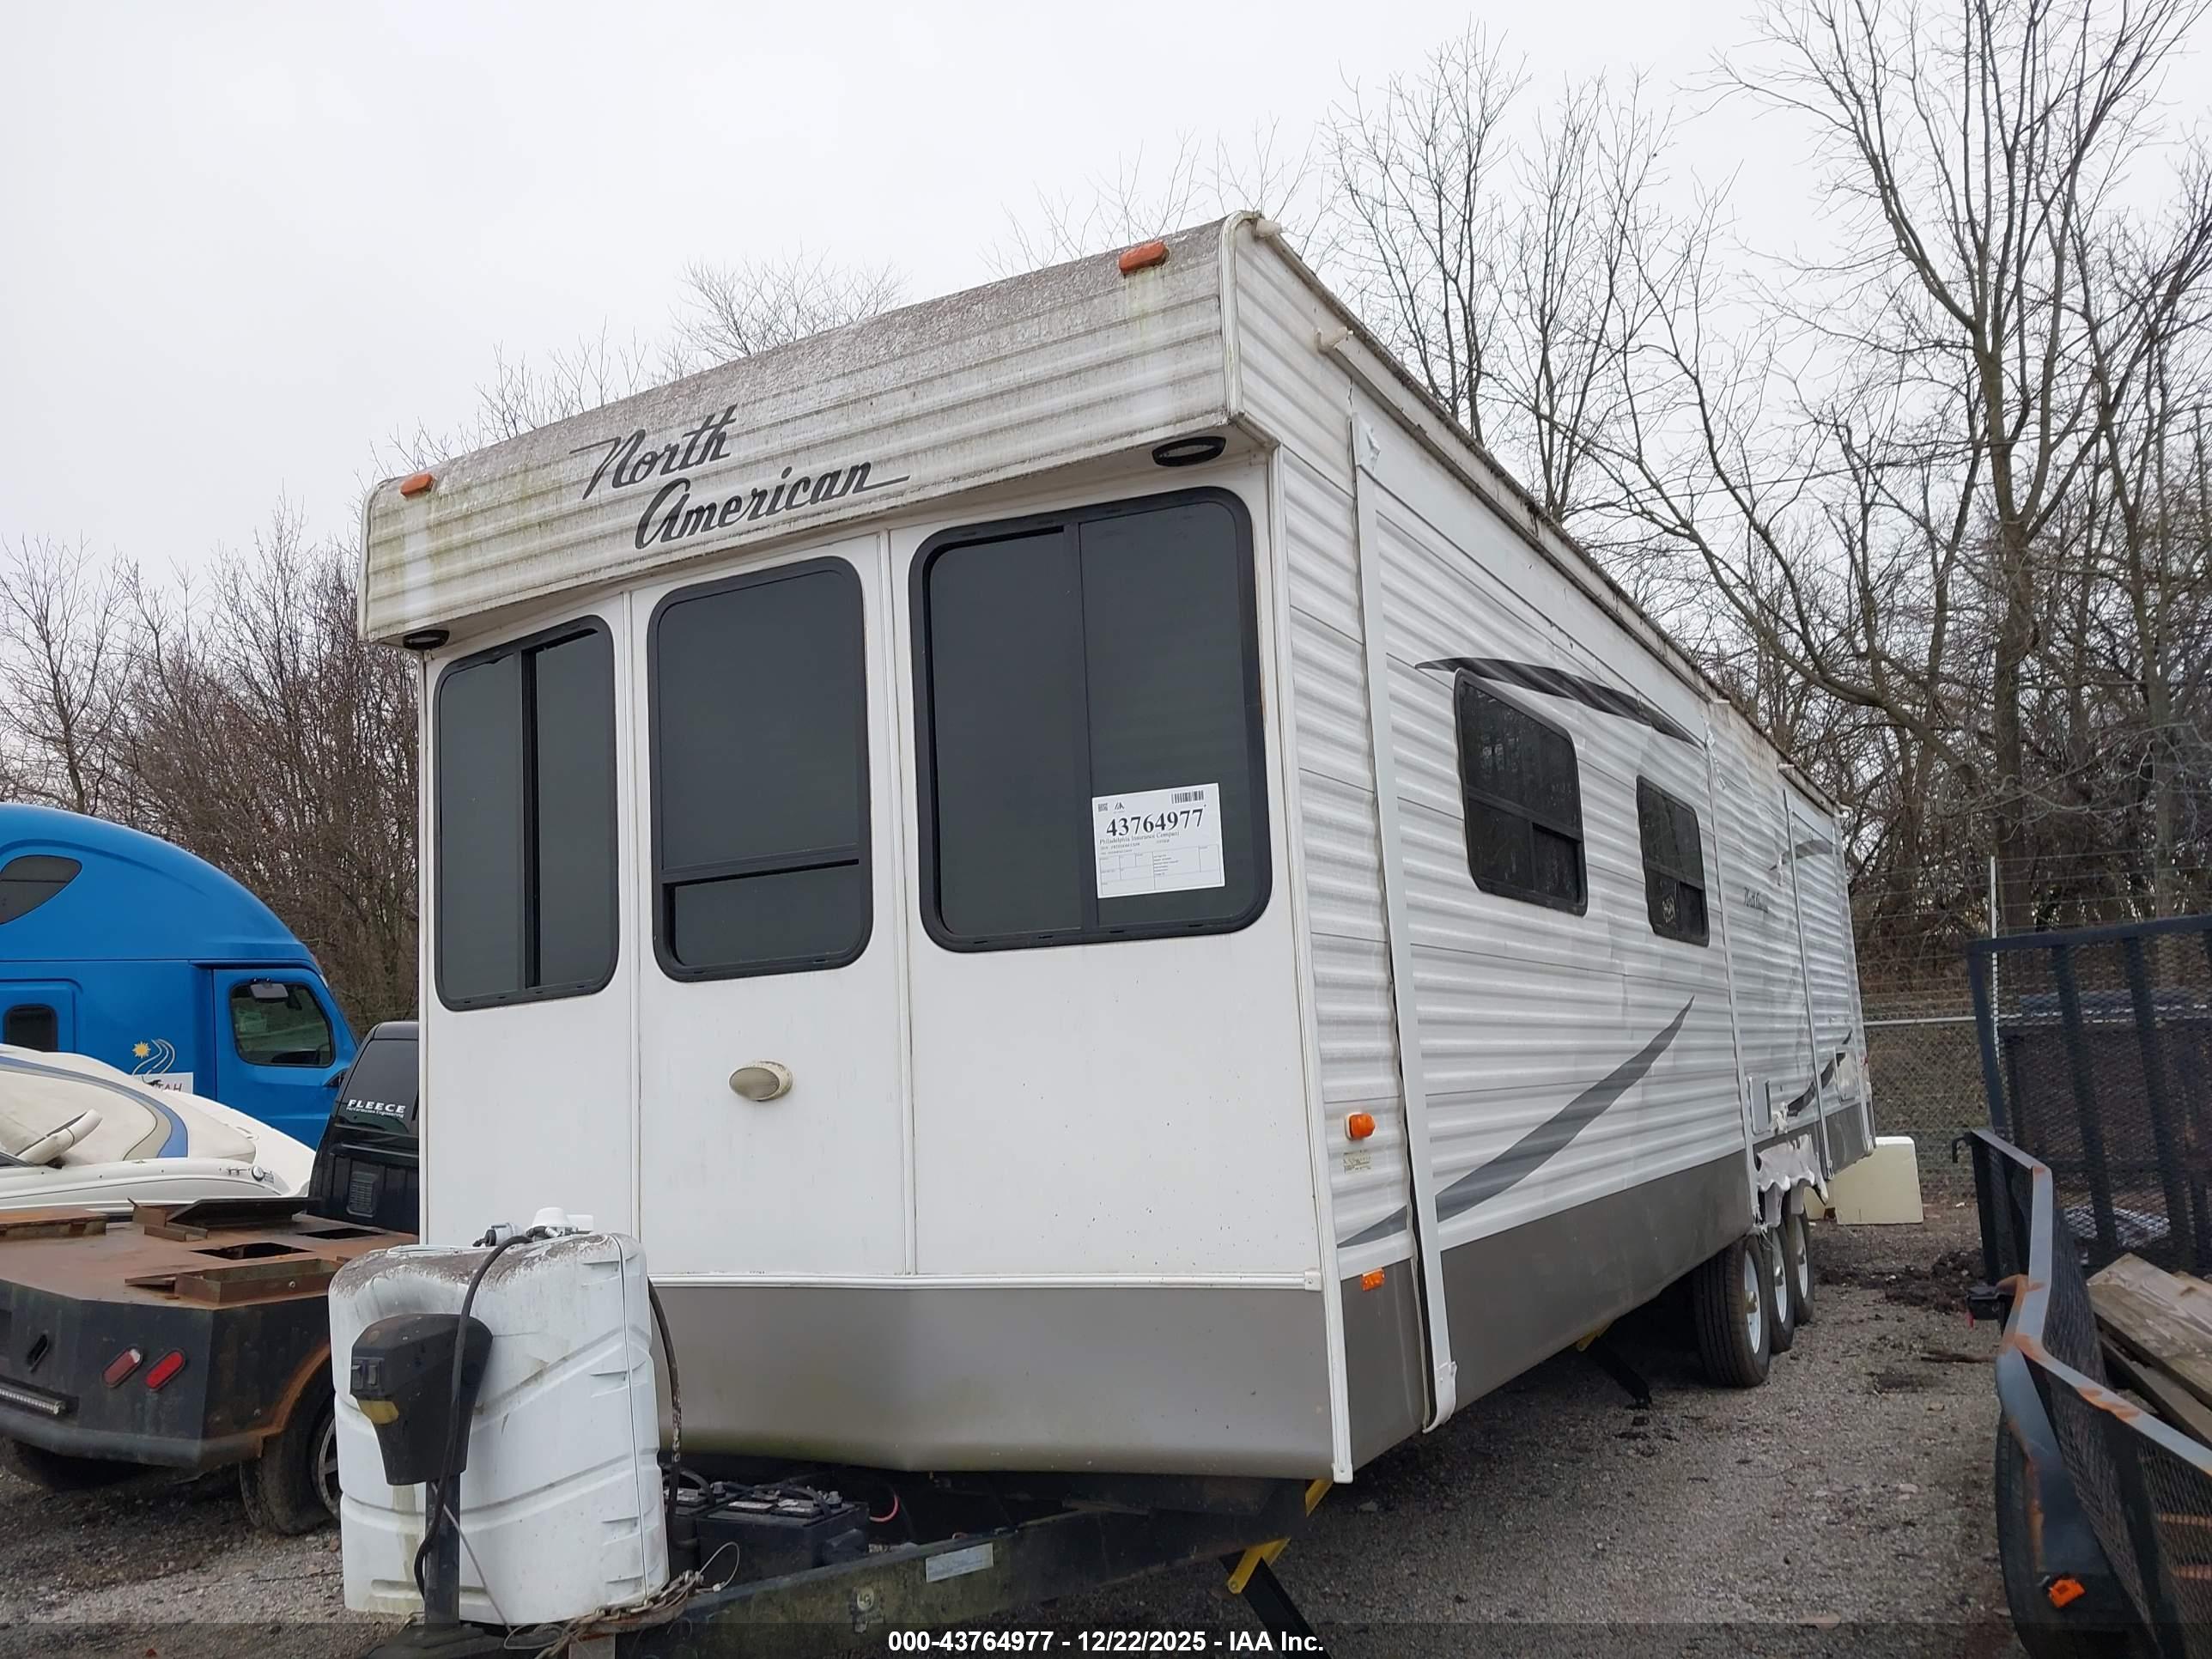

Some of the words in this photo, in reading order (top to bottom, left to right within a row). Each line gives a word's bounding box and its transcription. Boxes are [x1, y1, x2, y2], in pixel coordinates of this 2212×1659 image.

[569, 404, 738, 500] North
[635, 461, 910, 550] American
[1106, 809, 1204, 836] 43764977
[347, 1099, 406, 1114] FLEECE
